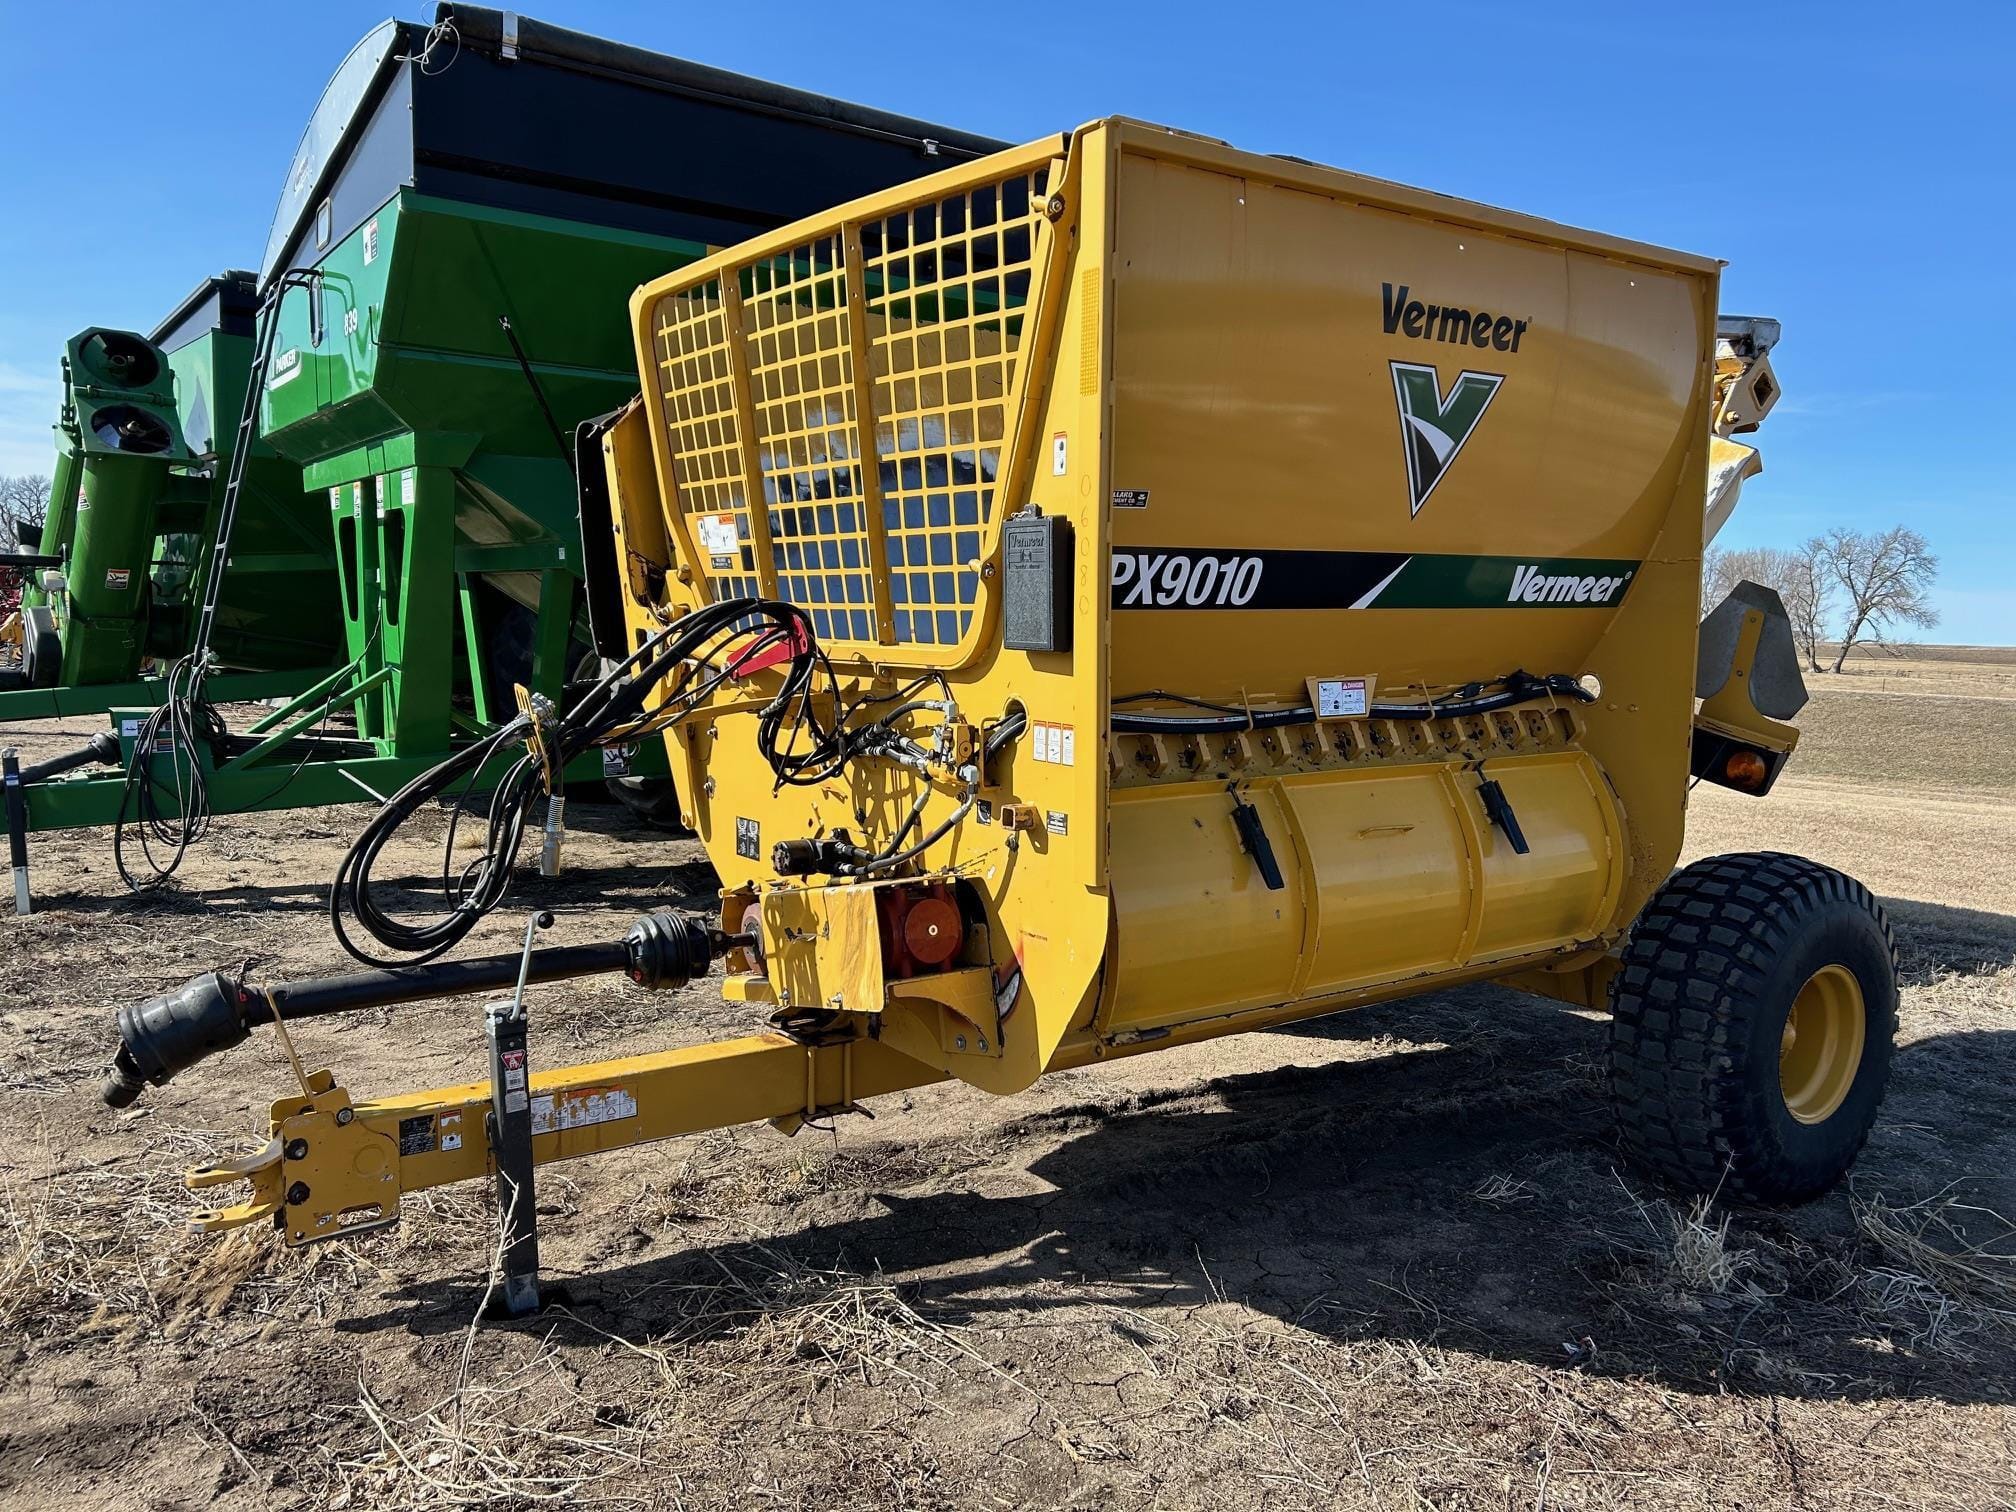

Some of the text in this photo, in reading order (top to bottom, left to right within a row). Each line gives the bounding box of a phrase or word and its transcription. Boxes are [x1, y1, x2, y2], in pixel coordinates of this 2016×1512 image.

[344, 307, 358, 337] 839
[1382, 282, 1527, 353] Vermeer
[276, 349, 296, 375] PARKER
[1112, 554, 1624, 606] PX9010 Vermeer
